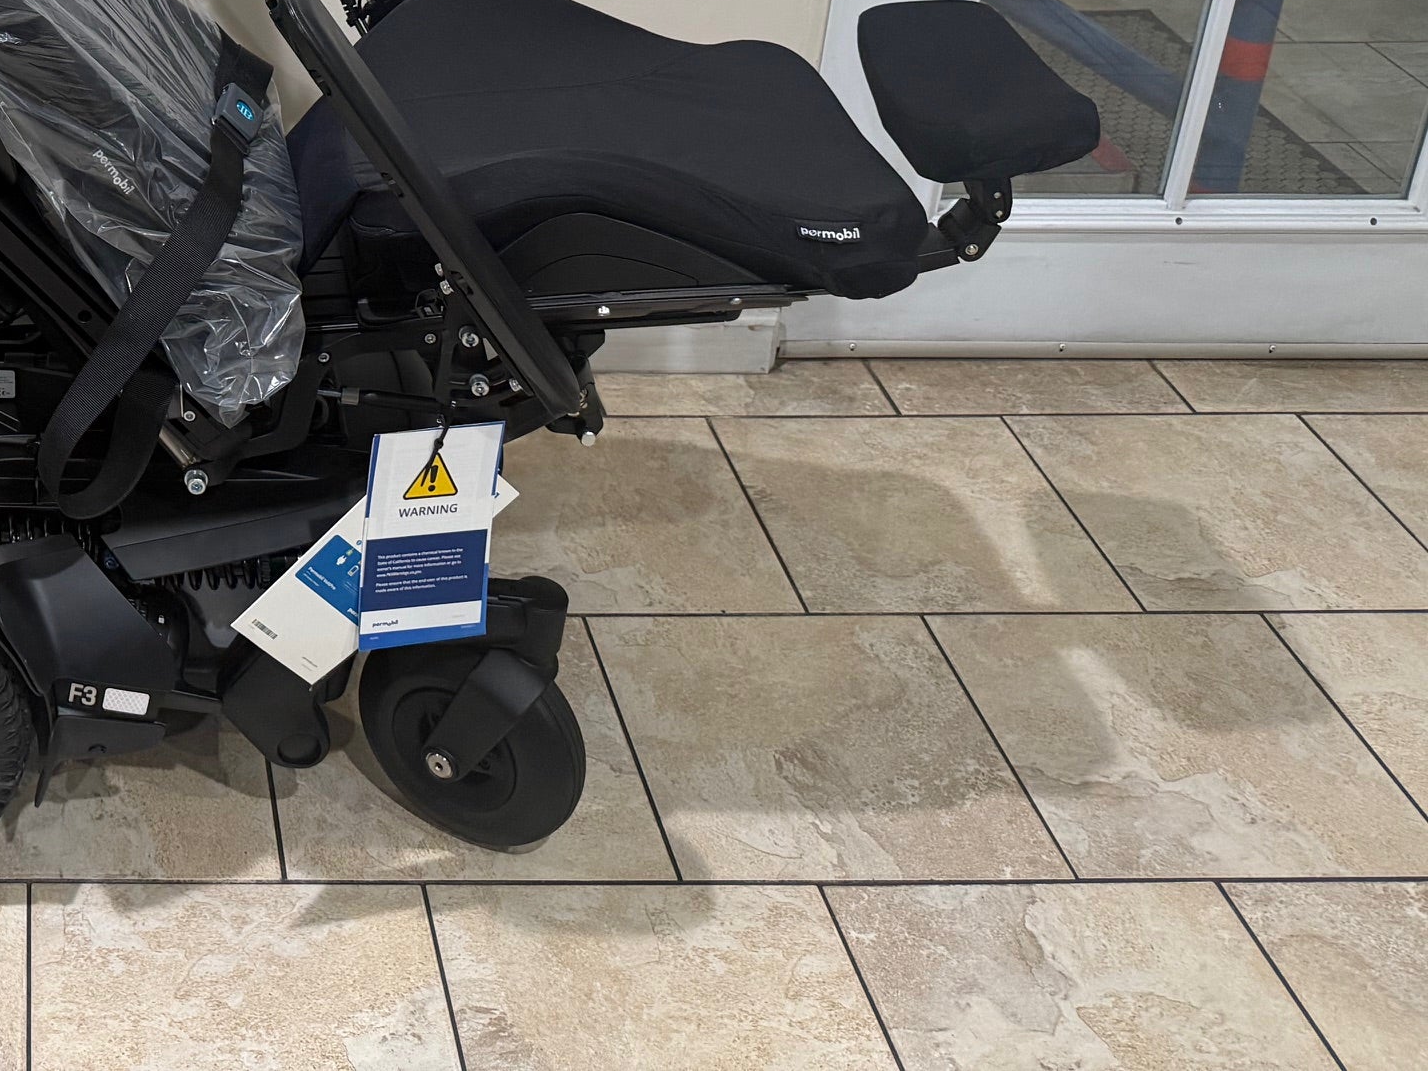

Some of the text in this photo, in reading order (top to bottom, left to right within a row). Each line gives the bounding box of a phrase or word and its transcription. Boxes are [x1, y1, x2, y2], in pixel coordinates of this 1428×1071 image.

[92, 149, 135, 195] permobil
[800, 226, 860, 241] permobil
[398, 504, 458, 518] WARNING
[372, 619, 399, 628] permobil
[68, 682, 97, 706] F3
